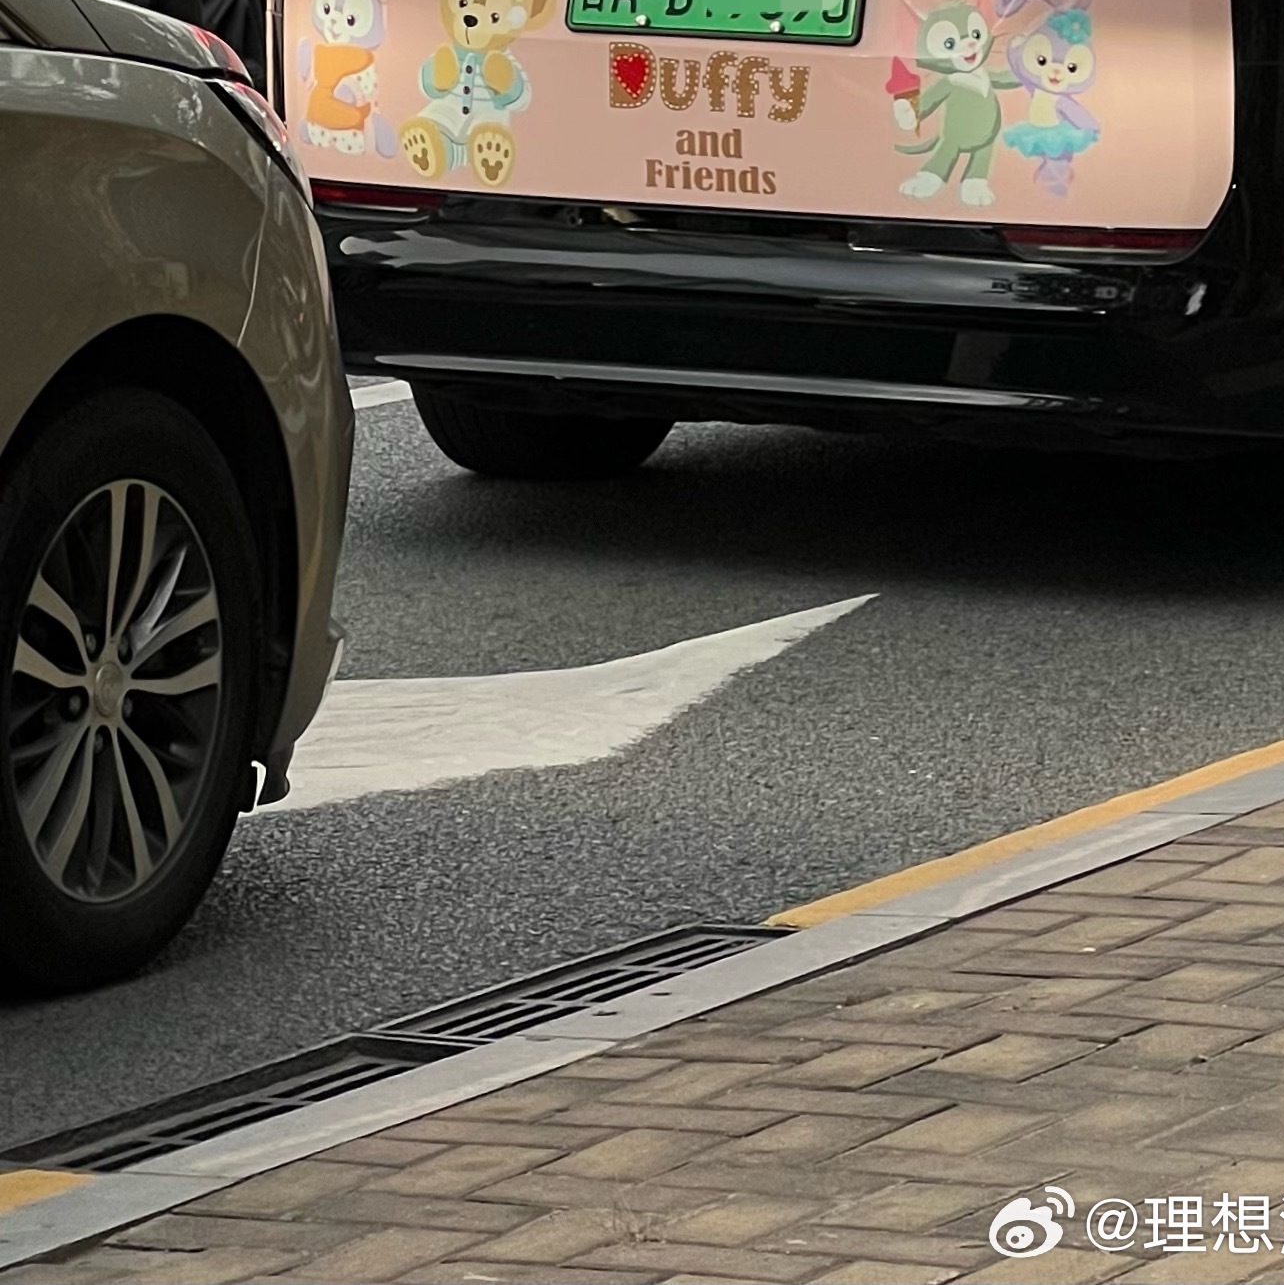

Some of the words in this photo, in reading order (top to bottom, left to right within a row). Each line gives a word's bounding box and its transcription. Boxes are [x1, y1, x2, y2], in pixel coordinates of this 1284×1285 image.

[609, 42, 811, 122] Duffy
[675, 128, 743, 159] and
[645, 158, 777, 195] Friends
